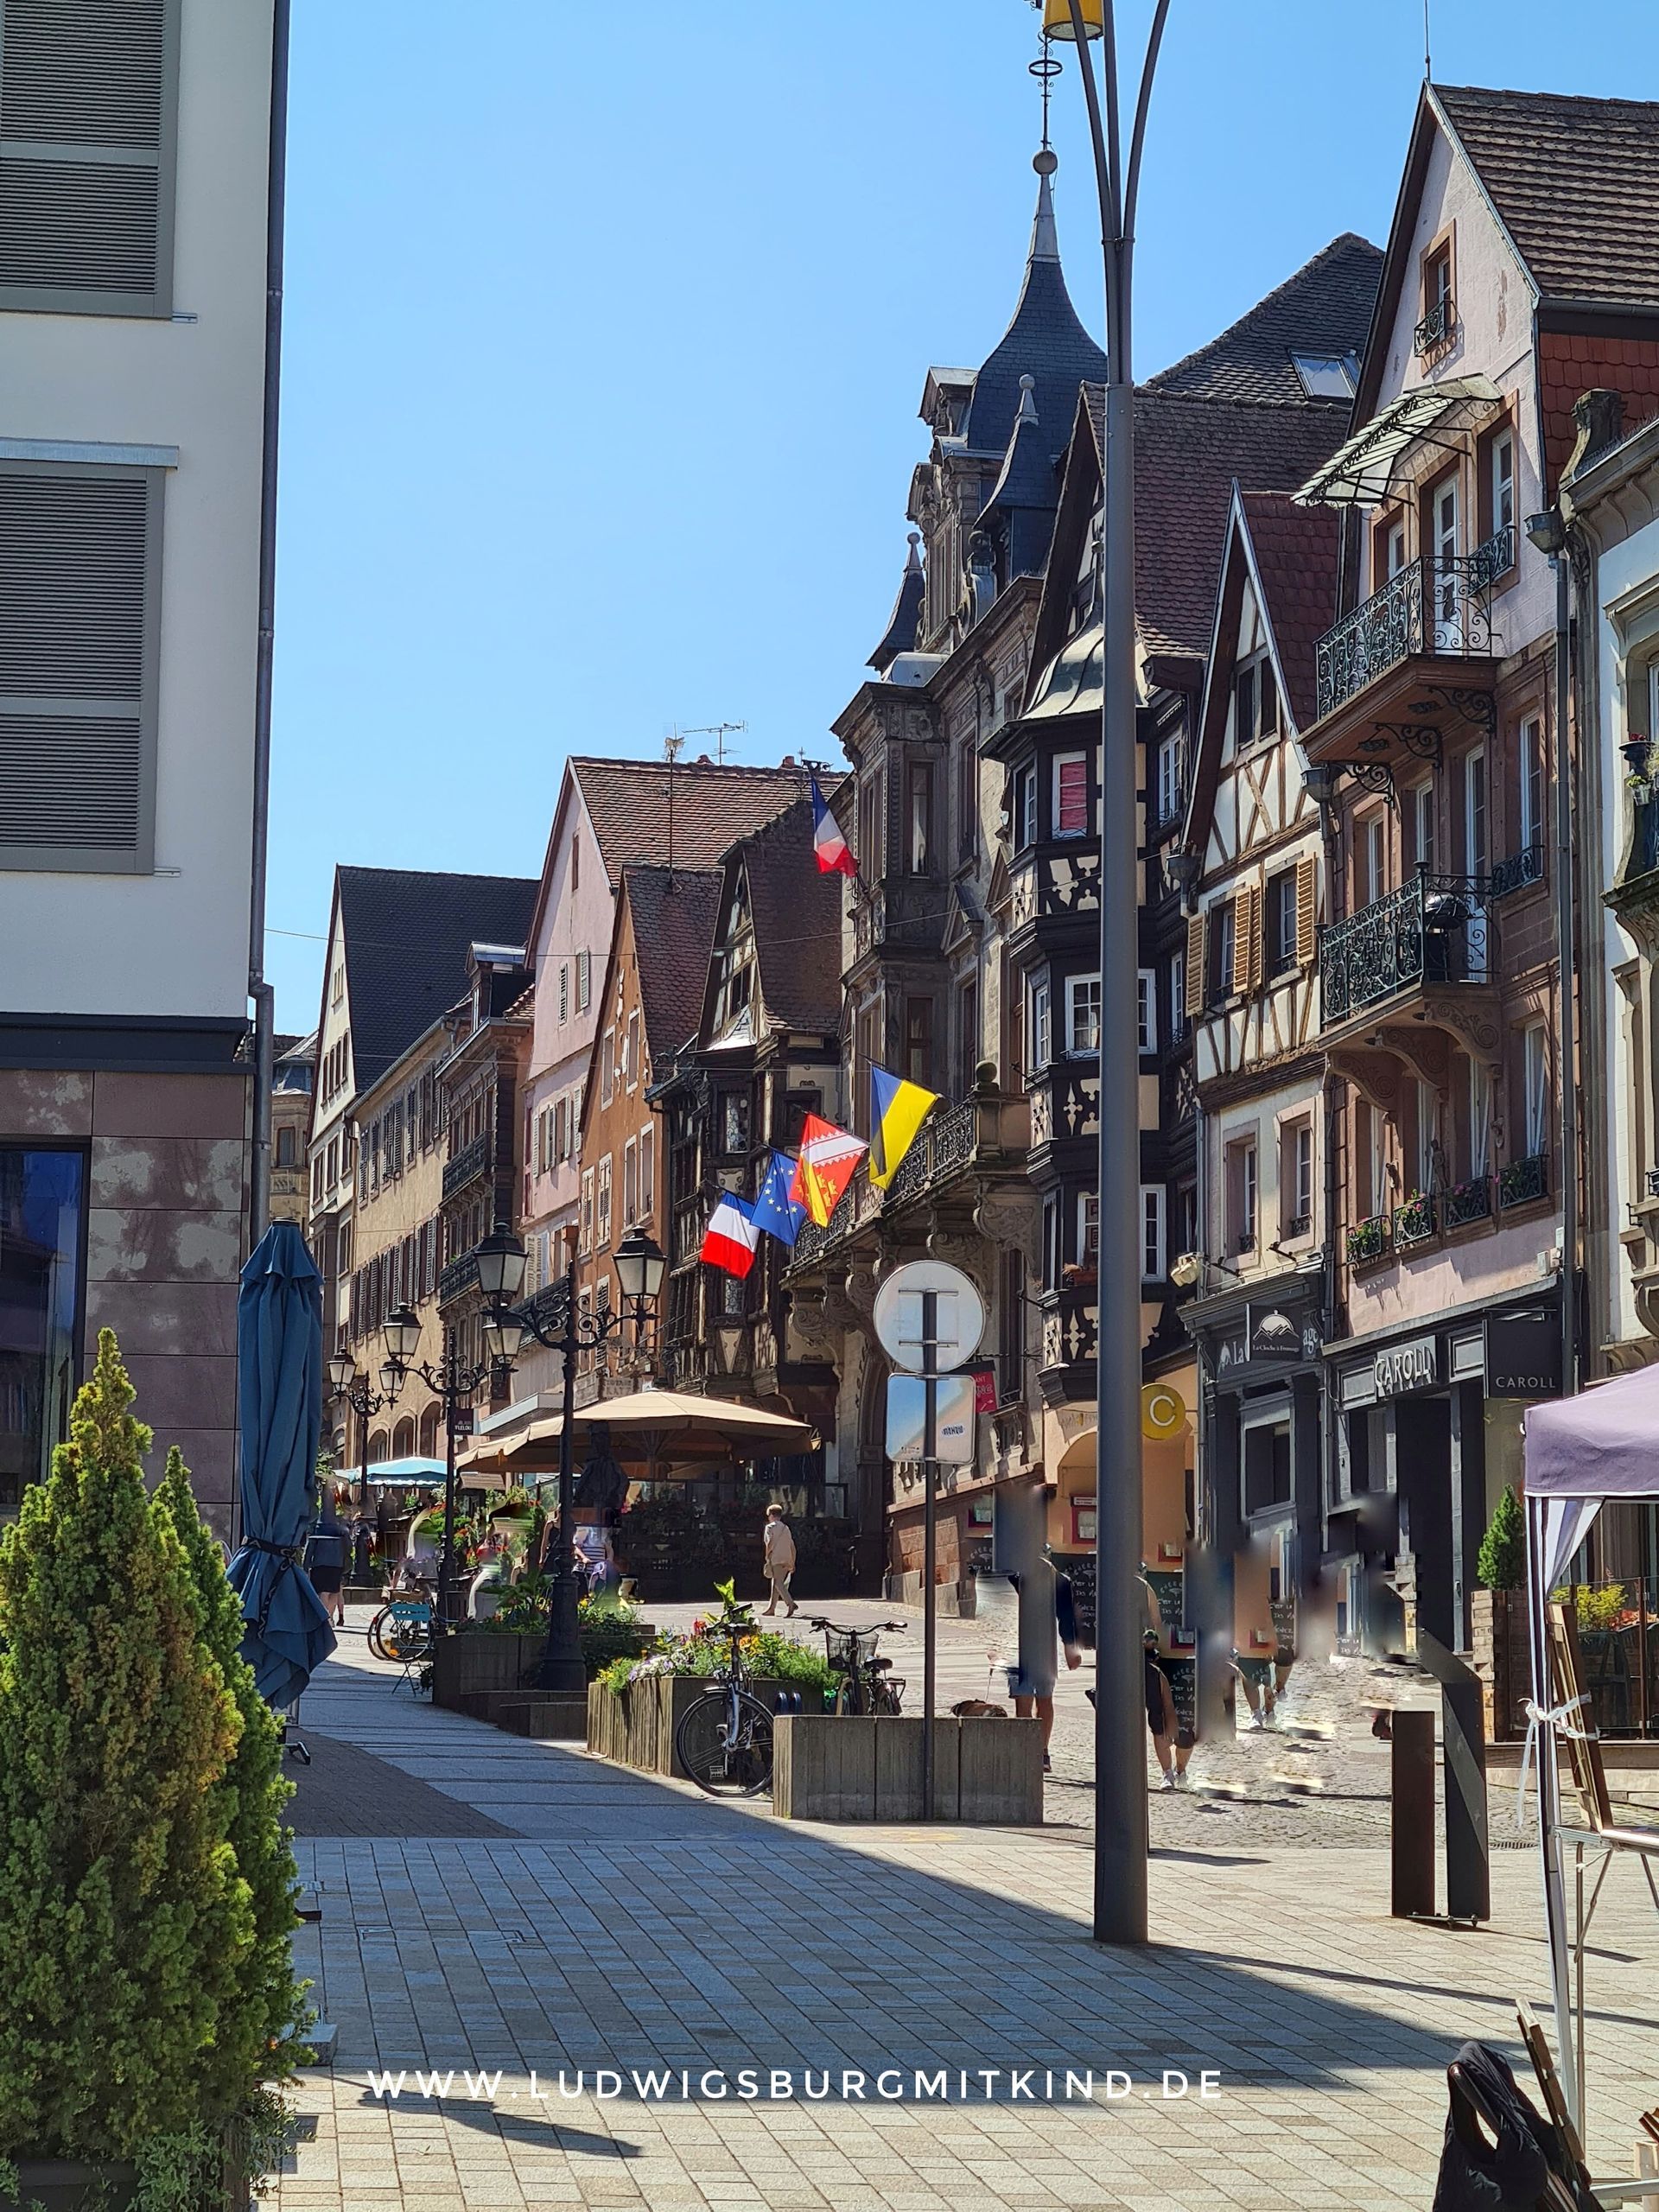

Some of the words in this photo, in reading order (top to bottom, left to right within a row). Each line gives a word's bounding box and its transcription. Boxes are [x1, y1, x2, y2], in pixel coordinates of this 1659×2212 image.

[1375, 1346, 1430, 1388] CAROLL
[1496, 1376, 1556, 1388] CAROLL
[1149, 1395, 1176, 1427] C
